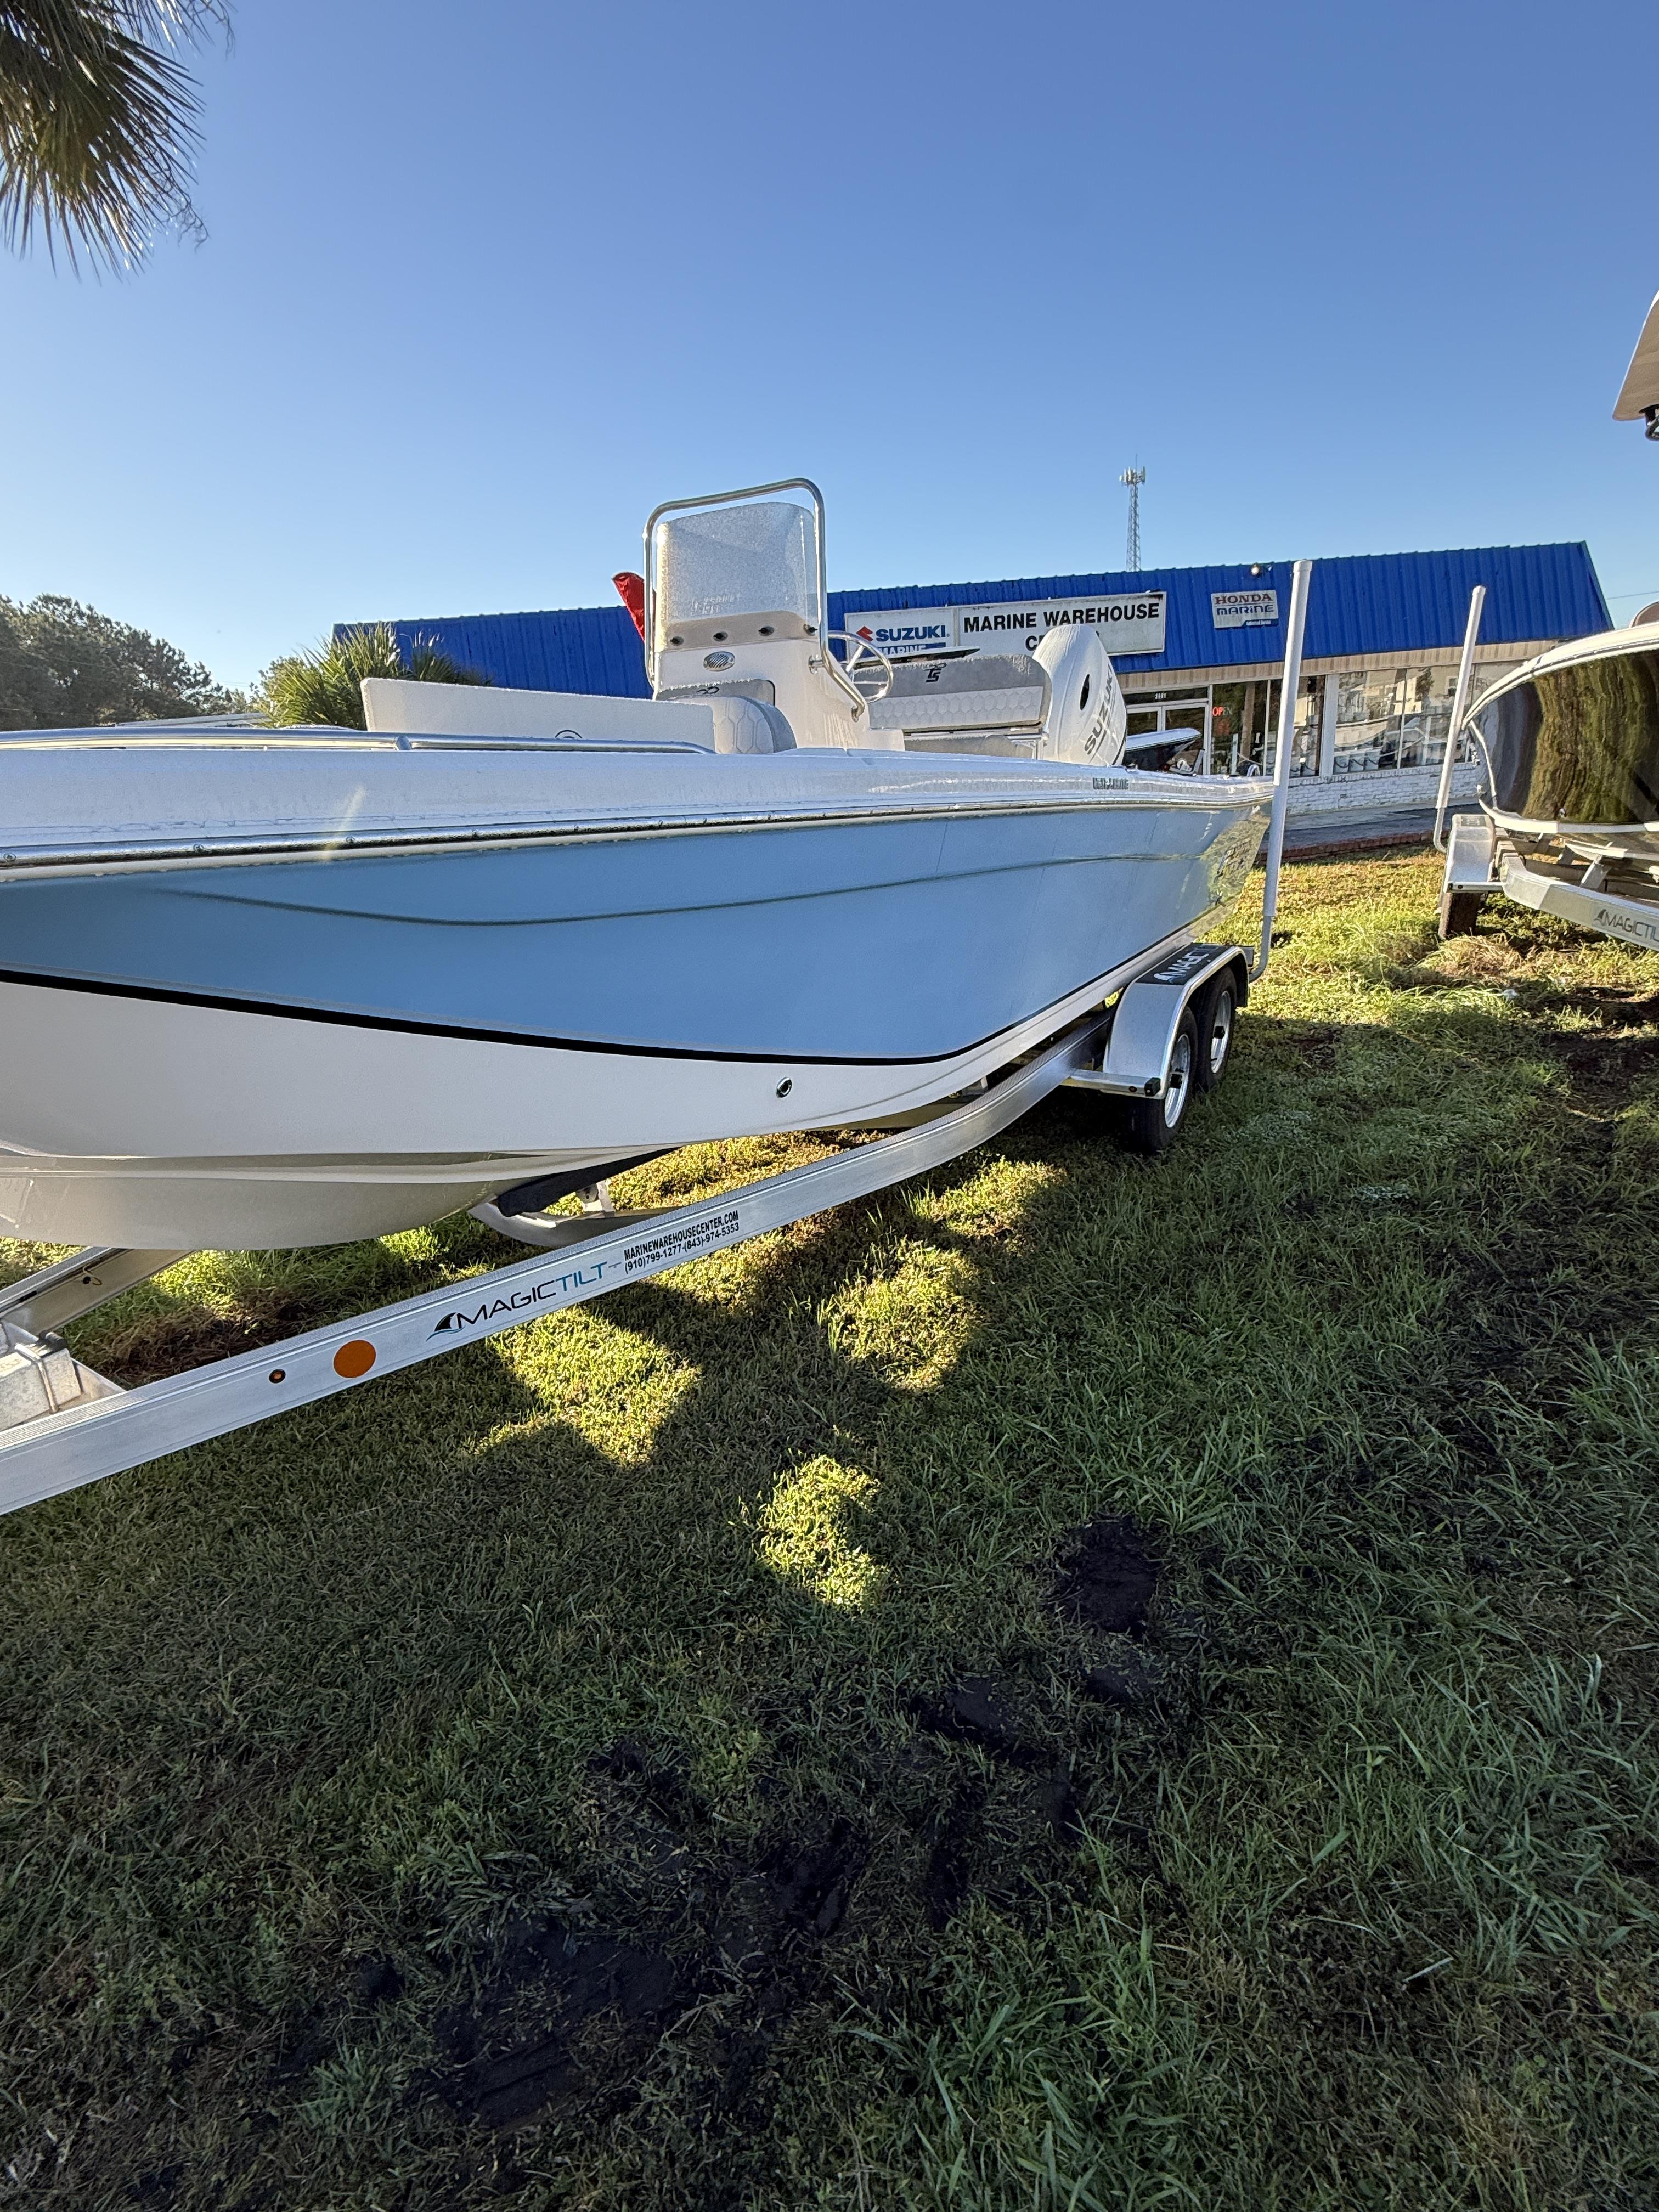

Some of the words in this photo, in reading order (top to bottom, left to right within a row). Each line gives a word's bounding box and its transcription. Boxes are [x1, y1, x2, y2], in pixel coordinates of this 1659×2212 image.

[964, 612, 1037, 633] MARINE
[1043, 602, 1160, 627] WAREHOUSE
[1215, 594, 1273, 605] HONDA
[876, 624, 946, 642] SUZUKI
[1084, 662, 1113, 755] SUZUKI
[1212, 706, 1233, 716] OPEN
[624, 1210, 738, 1261] MARINEWAREHOUSECENTER.COM
[625, 1222, 740, 1274] (910)799-1277-(843)-974-5353
[456, 1261, 608, 1329] MAGICTILT
